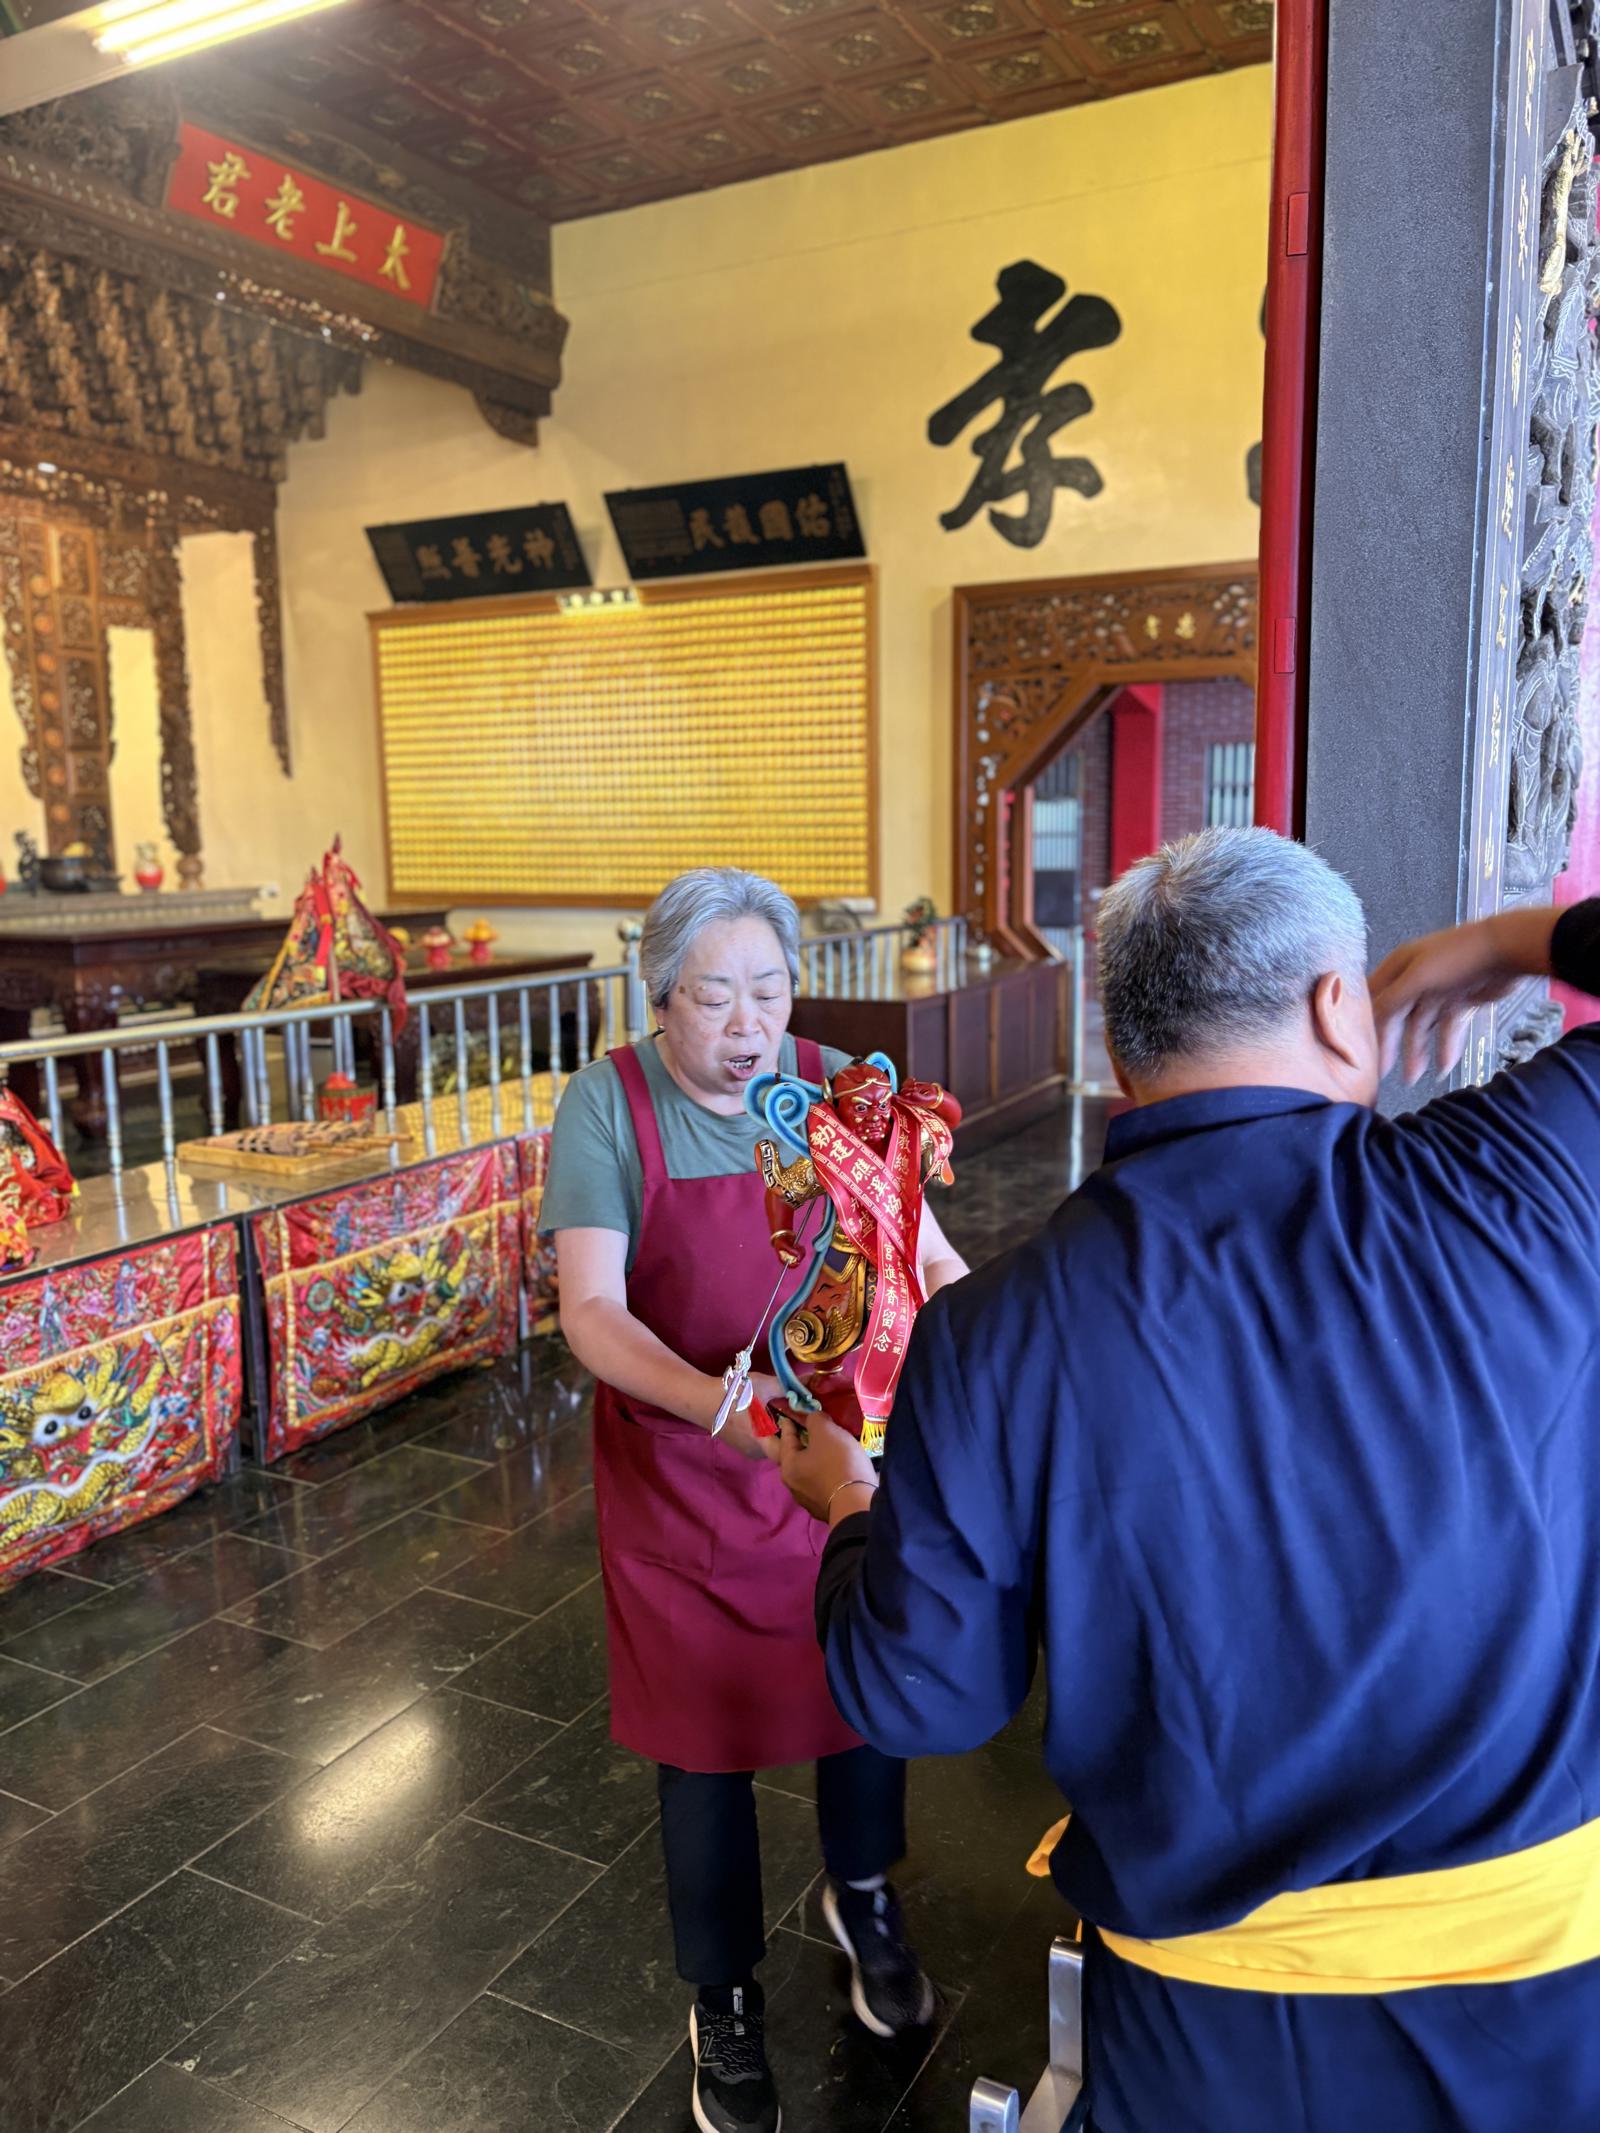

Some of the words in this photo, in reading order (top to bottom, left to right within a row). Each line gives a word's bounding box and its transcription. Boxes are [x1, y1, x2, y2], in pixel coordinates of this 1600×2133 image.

[203, 152, 410, 290] 太上老君
[927, 258, 1122, 549] 孝
